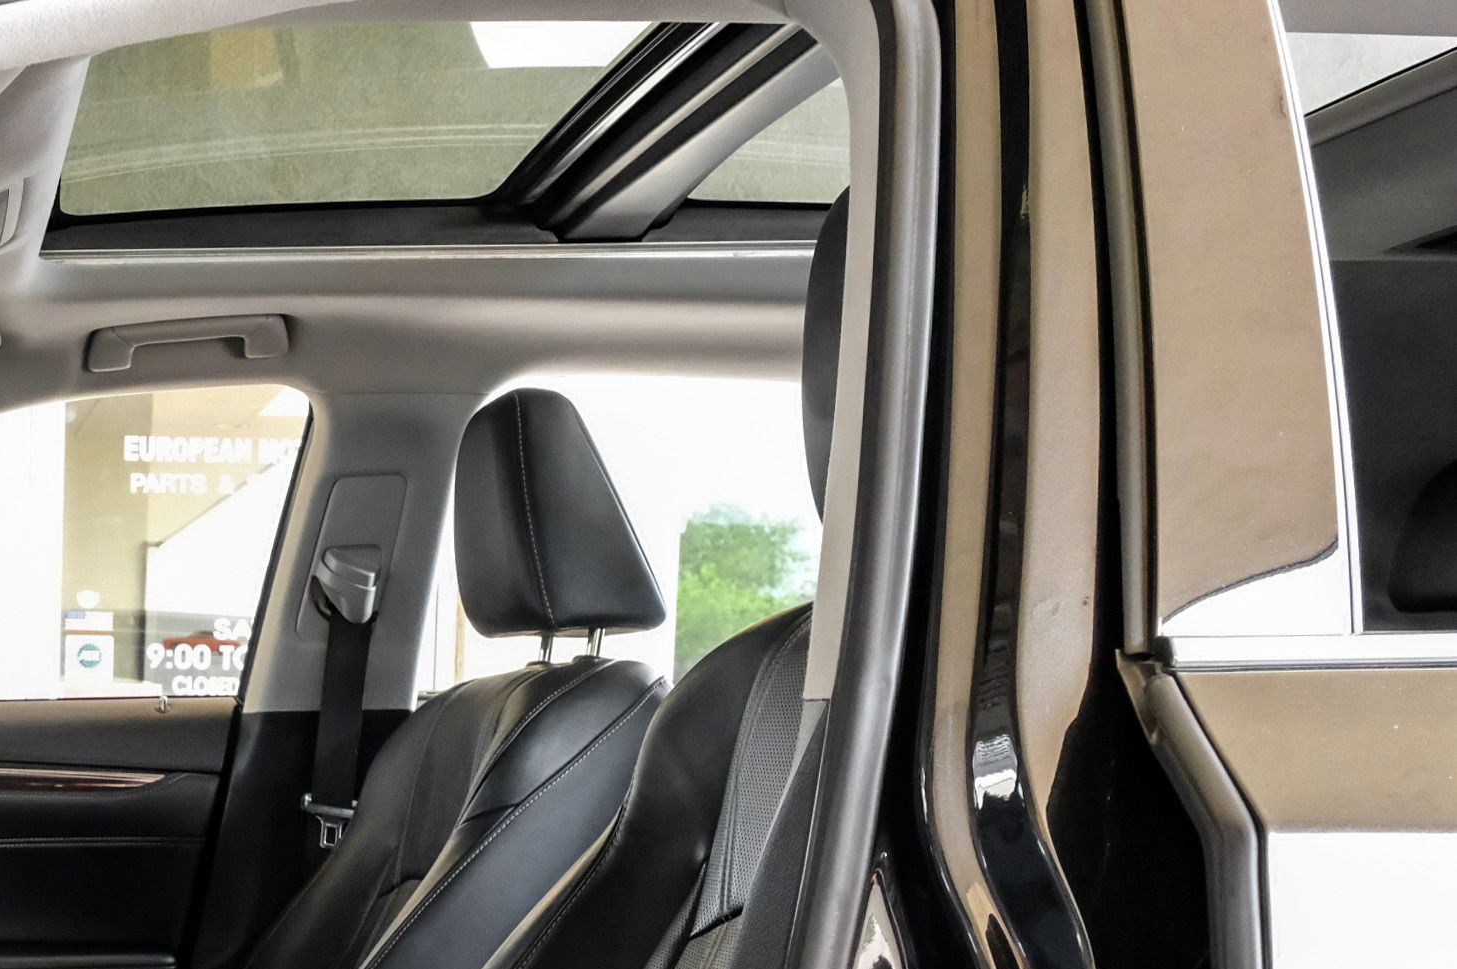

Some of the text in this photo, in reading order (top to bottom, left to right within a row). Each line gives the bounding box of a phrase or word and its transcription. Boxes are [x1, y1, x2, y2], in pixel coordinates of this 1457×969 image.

[124, 435, 252, 462] EUROPEAN
[130, 472, 208, 494] PARTS
[213, 617, 252, 640] SA
[147, 643, 212, 671] 9:00
[171, 675, 240, 697] CLOSED
